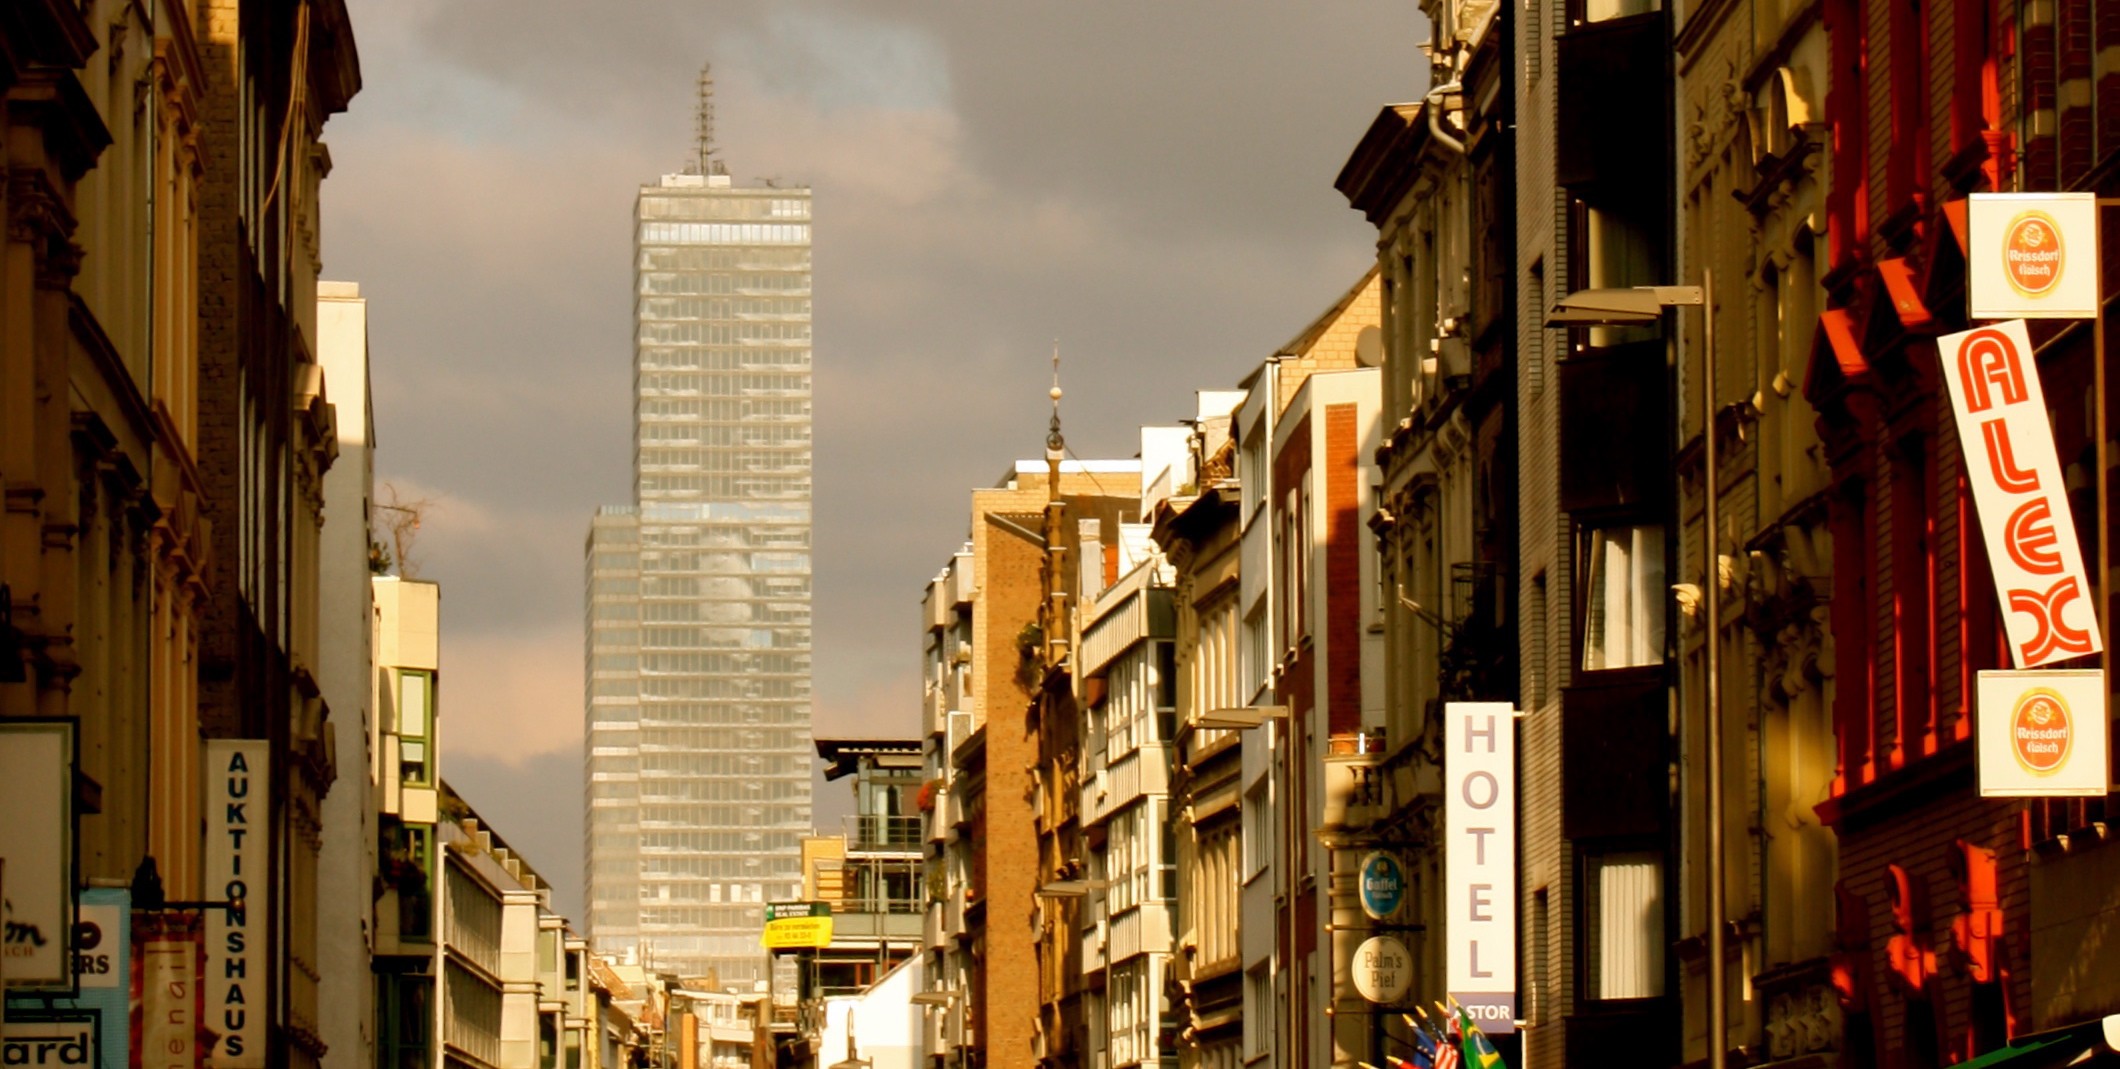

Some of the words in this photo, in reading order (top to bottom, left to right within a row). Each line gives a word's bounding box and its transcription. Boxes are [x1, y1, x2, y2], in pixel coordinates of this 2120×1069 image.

[1956, 327, 2093, 667] ALEX
[225, 752, 248, 1057] AUKTIONSHAUS
[1462, 715, 1499, 978] HOTEL
